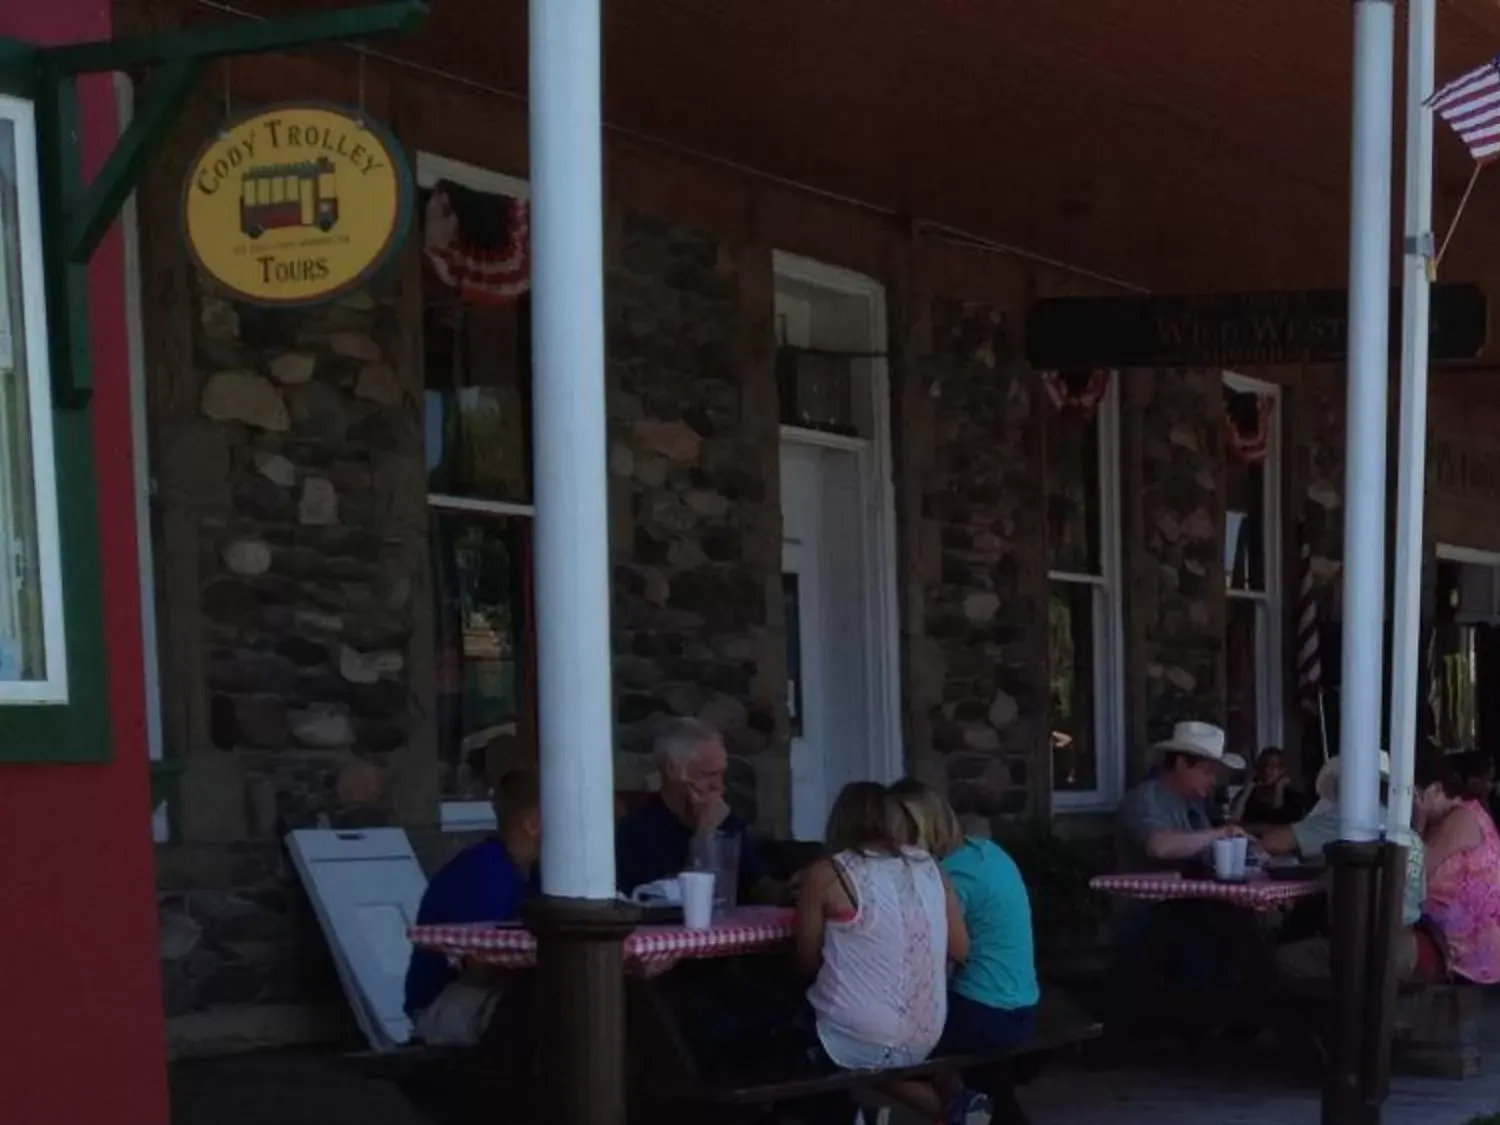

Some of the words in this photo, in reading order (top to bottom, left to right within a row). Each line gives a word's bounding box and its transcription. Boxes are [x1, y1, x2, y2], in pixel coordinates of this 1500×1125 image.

[197, 131, 257, 196] CODY
[264, 119, 384, 176] TROLLEY
[256, 255, 330, 284] TOURS
